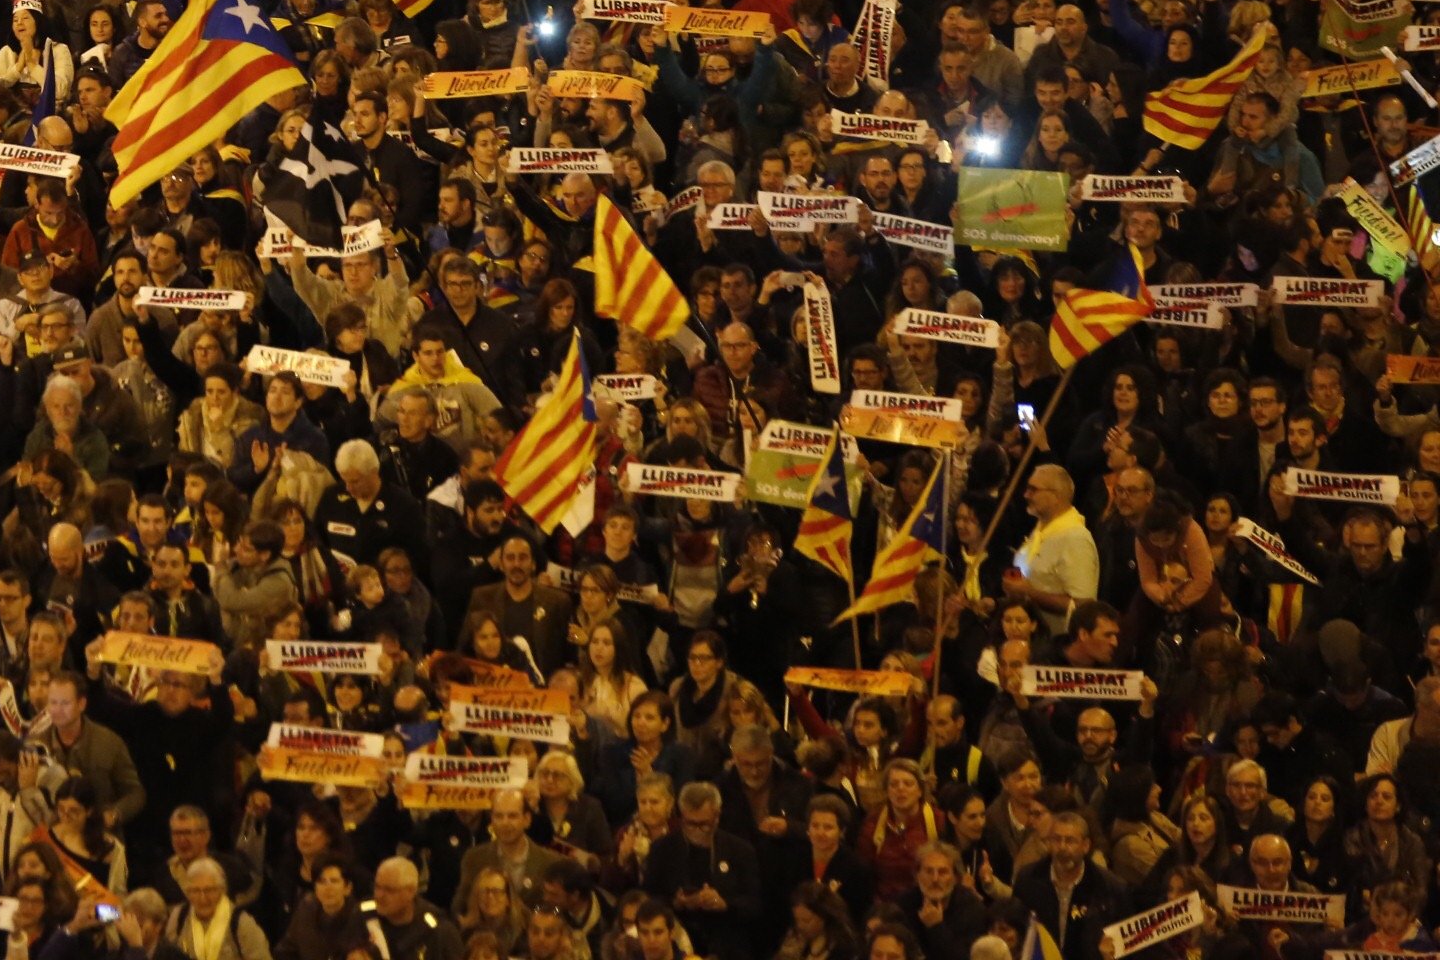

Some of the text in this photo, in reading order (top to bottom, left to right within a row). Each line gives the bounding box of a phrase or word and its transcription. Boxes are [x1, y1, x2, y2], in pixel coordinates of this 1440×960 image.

[842, 117, 917, 135] LLIBERTAT
[0, 146, 67, 168] LLIBERTAT
[519, 152, 598, 164] LLIBERTAT
[1093, 179, 1173, 192] LLIBERTAT
[772, 198, 849, 212] LLIBERTAT
[877, 219, 952, 241] LLIBERTAT
[964, 229, 988, 241] SOS
[152, 289, 234, 302] LLIBERTAT
[1287, 282, 1369, 296] LLIBERTAT
[909, 316, 987, 336] LLIBERTAT
[806, 298, 827, 379] LLIBERTAT
[865, 396, 948, 415] LLIBERTAT
[643, 471, 725, 490] LLIBERTAT
[1297, 472, 1381, 493] LLIBERTAT
[280, 646, 366, 662] LLIBERTAT
[1035, 671, 1126, 686] LLIBERTAT
[466, 708, 554, 727] LLIBERTAT
[420, 759, 509, 776] LLIBERTAT
[1231, 891, 1330, 911] LLIBERTAT
[1120, 900, 1193, 939] LLIBERTAT
